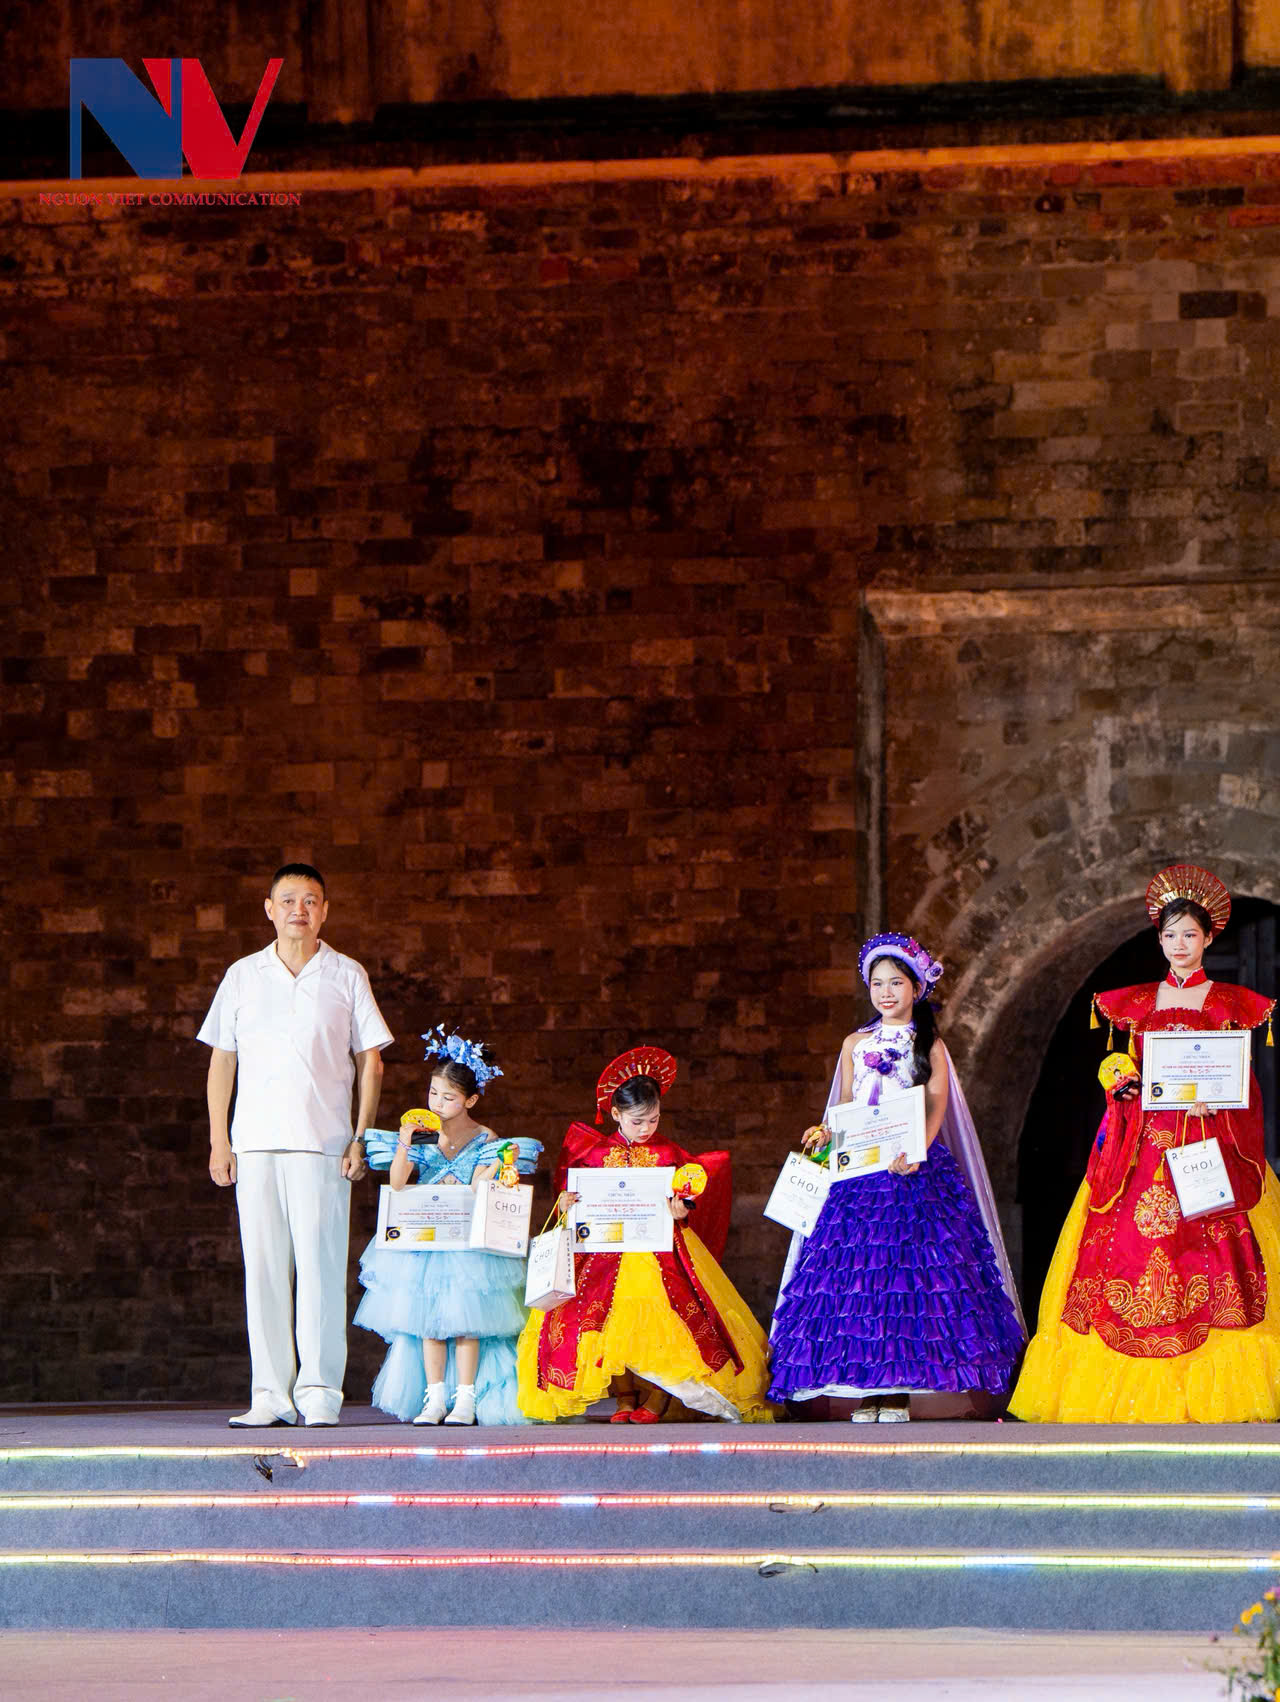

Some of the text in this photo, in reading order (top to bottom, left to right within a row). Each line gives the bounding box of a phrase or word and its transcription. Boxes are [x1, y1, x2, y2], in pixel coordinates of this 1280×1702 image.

[1182, 1160, 1213, 1173] CHOI
[790, 1176, 819, 1194] CHOI
[494, 1200, 522, 1214] CHOI
